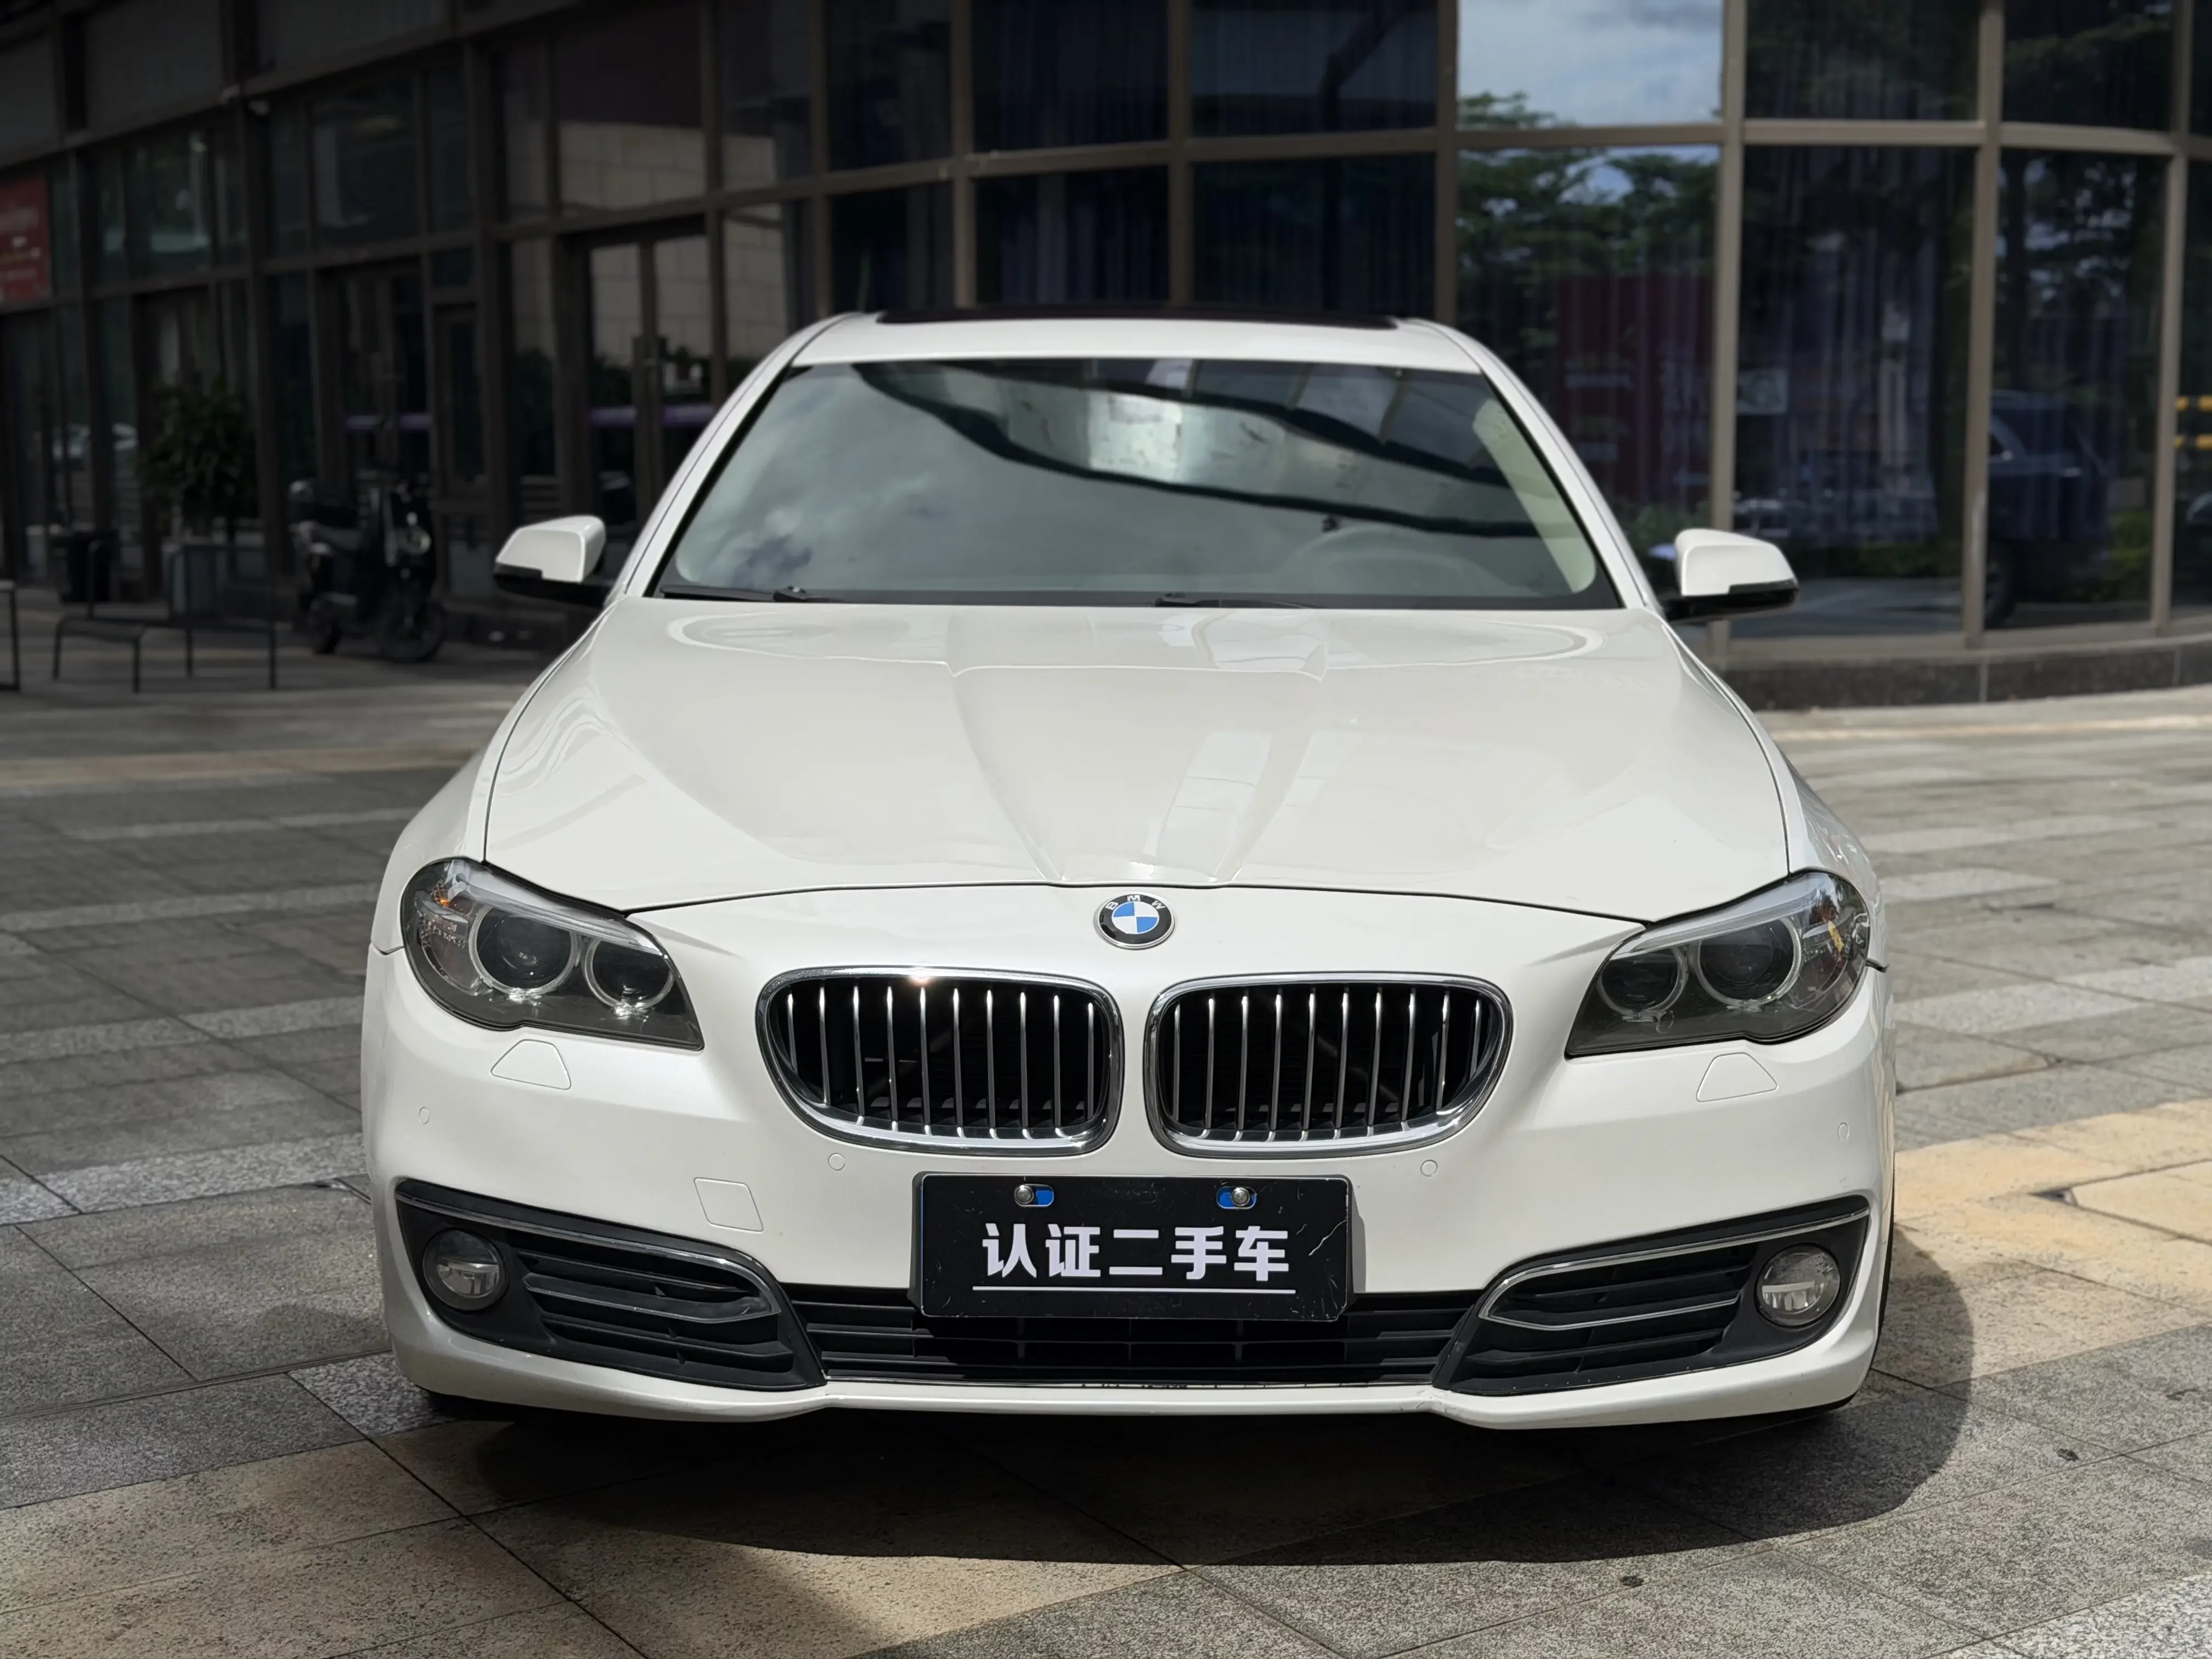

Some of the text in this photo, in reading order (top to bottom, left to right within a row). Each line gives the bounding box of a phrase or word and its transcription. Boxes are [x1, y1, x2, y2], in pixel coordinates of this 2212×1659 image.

[1105, 895, 1166, 910] BMW
[982, 1223, 1289, 1282] 认证二手车
